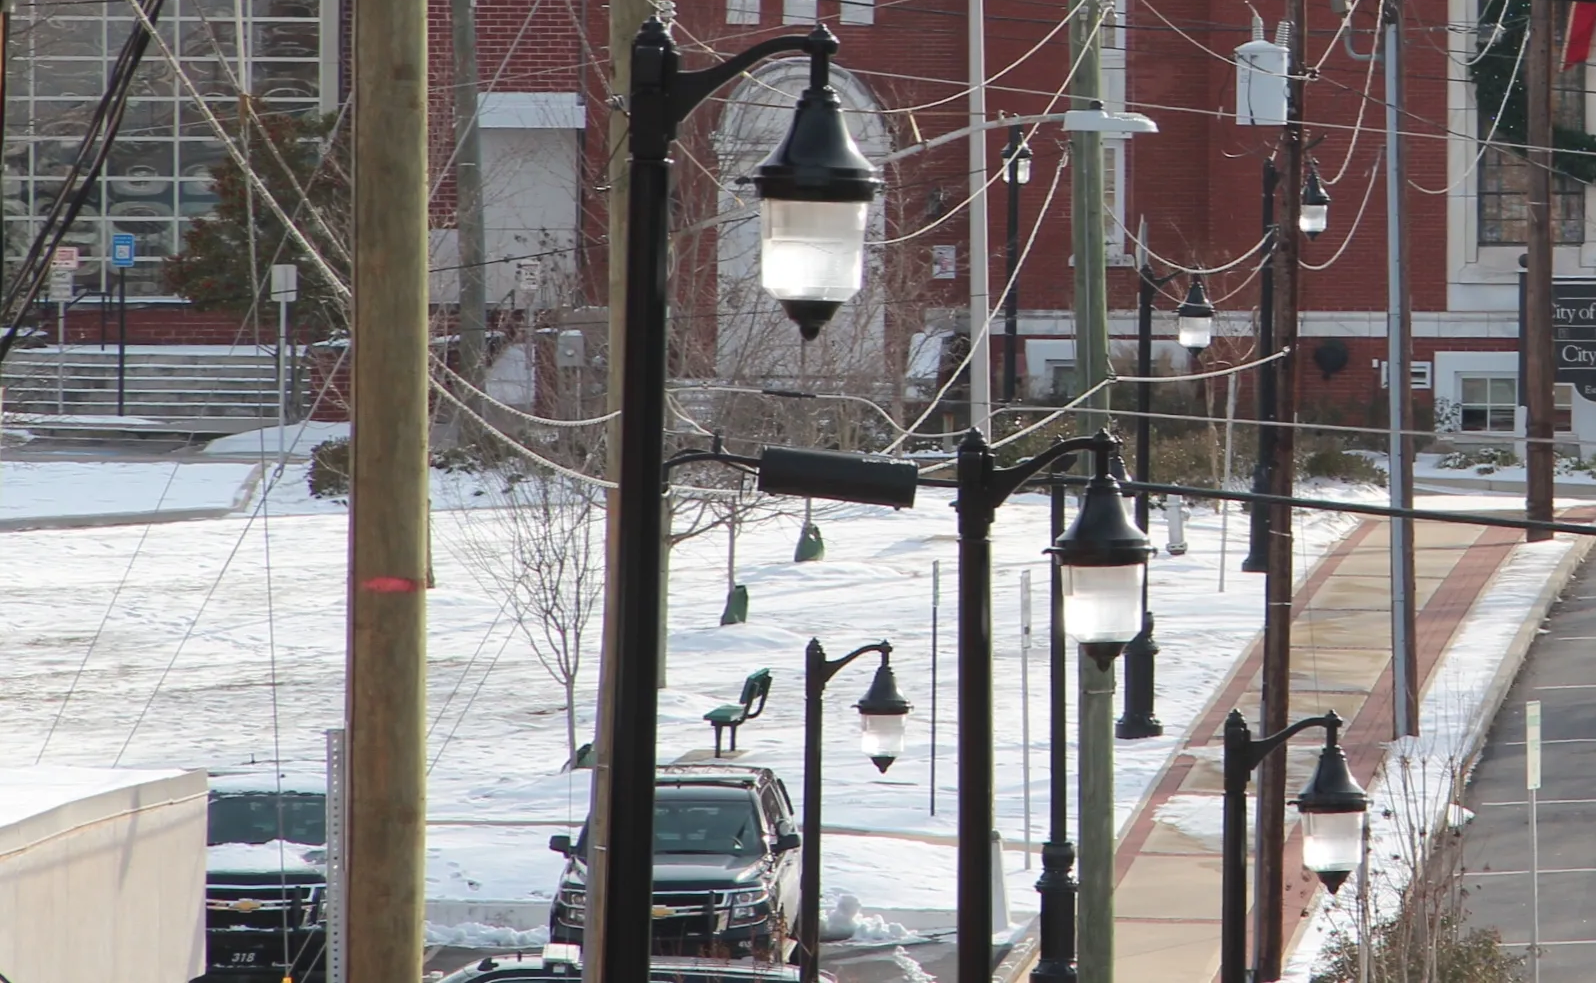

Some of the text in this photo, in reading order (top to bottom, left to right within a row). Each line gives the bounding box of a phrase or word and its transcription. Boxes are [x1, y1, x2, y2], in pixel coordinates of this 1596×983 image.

[1552, 302, 1576, 323] ity
[1578, 302, 1596, 320] of
[1562, 344, 1596, 365] City
[231, 952, 256, 963] 318
